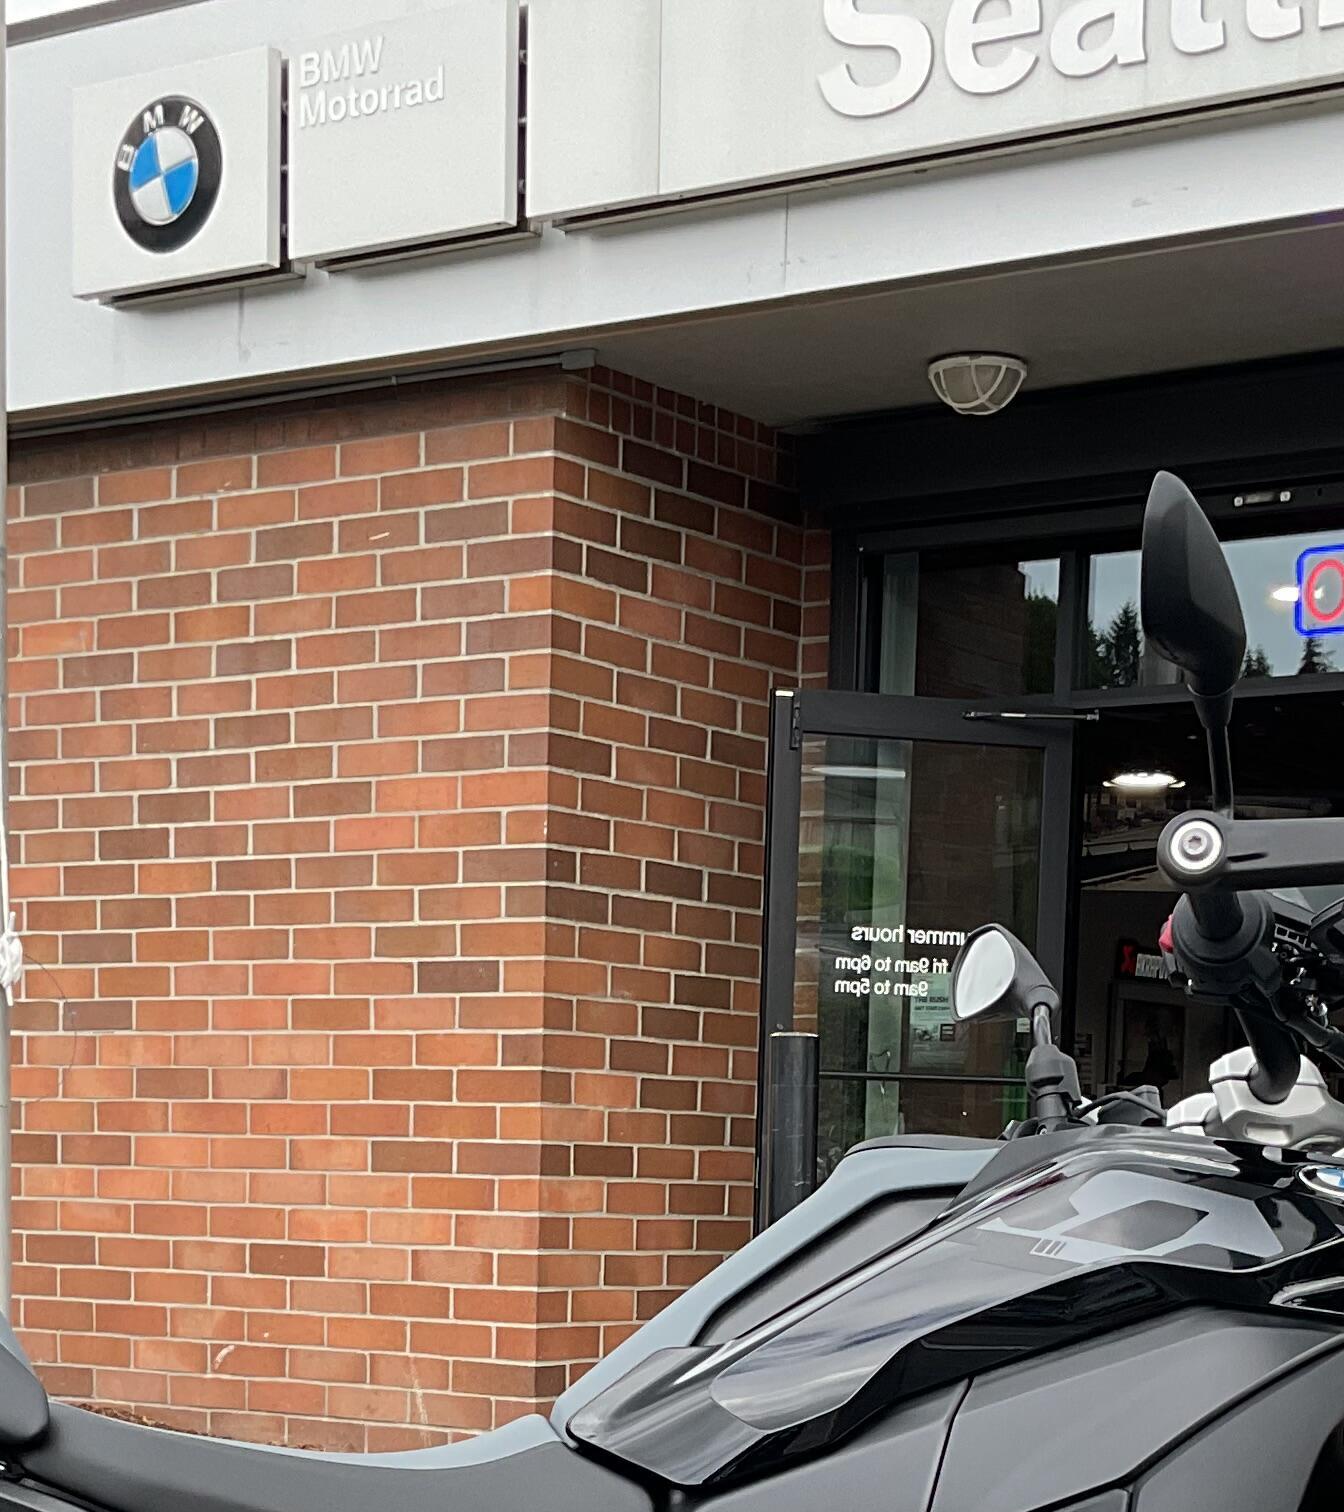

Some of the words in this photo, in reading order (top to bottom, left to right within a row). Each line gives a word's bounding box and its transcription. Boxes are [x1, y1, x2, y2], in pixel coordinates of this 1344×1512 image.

[299, 36, 385, 89] BMW
[299, 65, 445, 129] Motorrad
[117, 103, 205, 172] BMW
